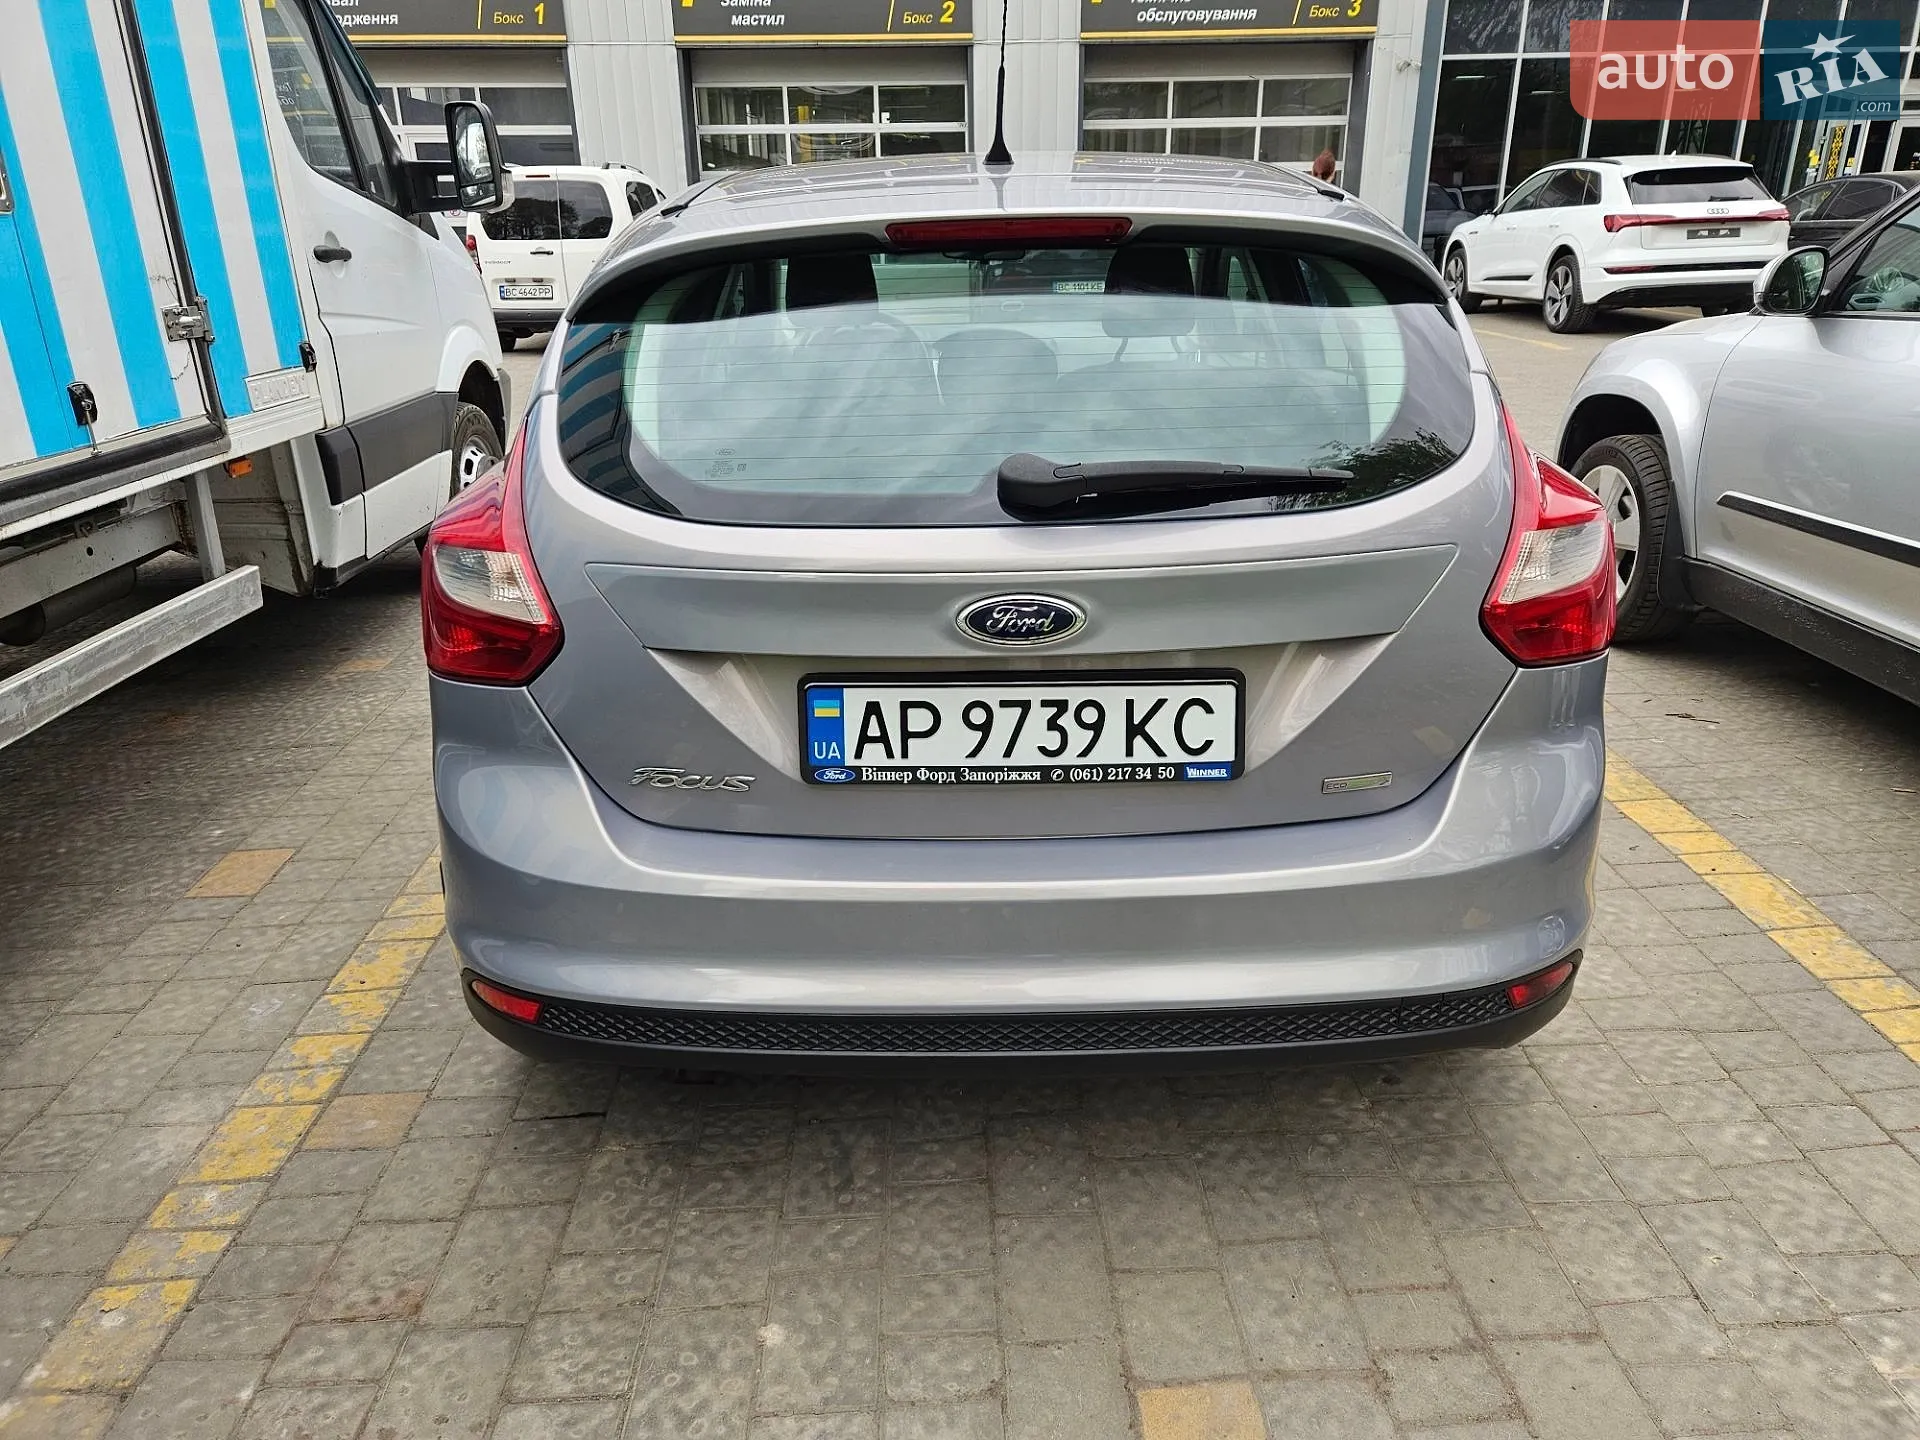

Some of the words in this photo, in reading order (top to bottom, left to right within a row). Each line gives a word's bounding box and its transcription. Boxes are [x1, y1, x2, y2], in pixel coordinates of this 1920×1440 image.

[493, 11, 524, 24] Бокс
[534, 2, 545, 25] 1
[903, 11, 933, 24] Бокс
[940, 0, 955, 23] 2
[1136, 7, 1258, 25] обслуговування
[1309, 4, 1340, 17] Бокс
[1347, 0, 1362, 17] 3
[731, 14, 785, 26] мастил
[505, 287, 518, 297] BC
[539, 287, 551, 297] PP
[985, 605, 1056, 634] Ford
[854, 700, 942, 760] AP
[961, 699, 1106, 758] 9739
[1125, 697, 1215, 758] KC
[814, 741, 841, 760] UA
[822, 769, 847, 781] Ford
[861, 767, 913, 783] Віннер
[916, 767, 956, 784] Форд
[960, 767, 1041, 784] Запоріжжя
[1069, 767, 1103, 782] (061)
[1107, 767, 1131, 781] 217
[1135, 767, 1152, 781] 34
[1158, 766, 1175, 780] 50
